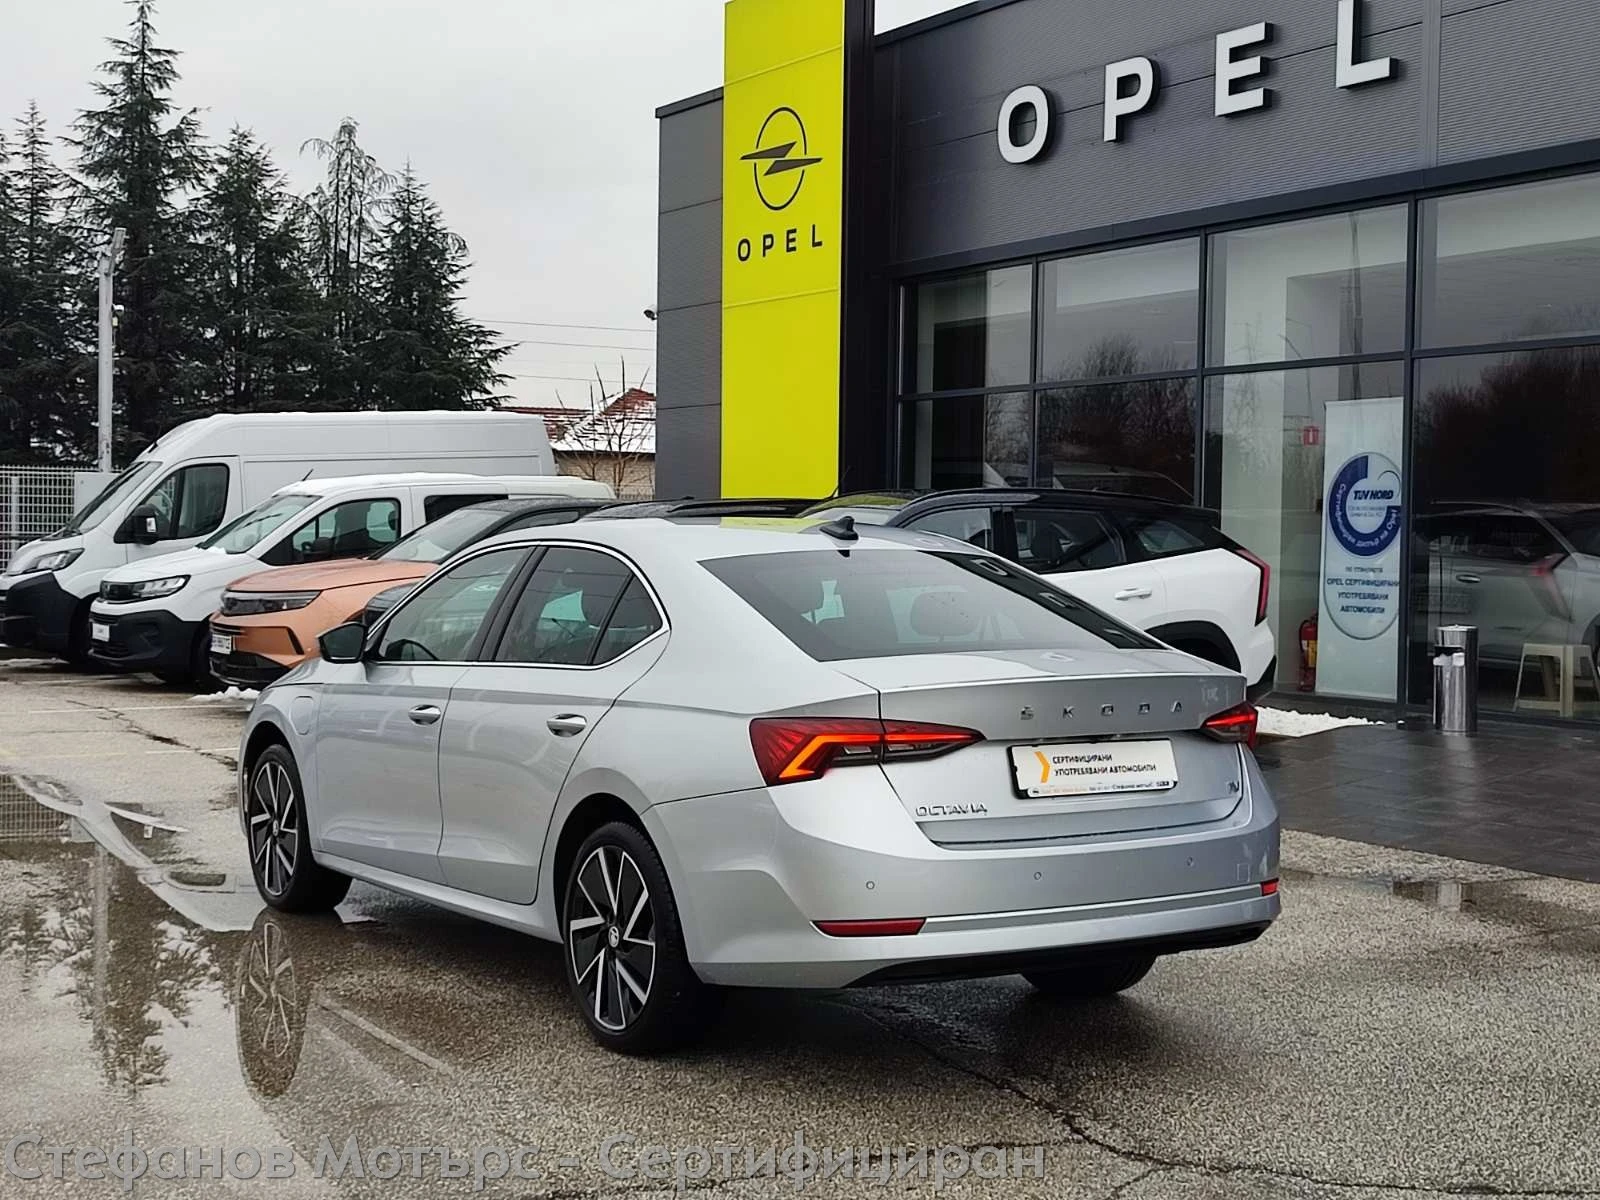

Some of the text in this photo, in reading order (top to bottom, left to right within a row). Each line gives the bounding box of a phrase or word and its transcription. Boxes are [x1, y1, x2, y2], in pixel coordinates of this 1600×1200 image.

[997, 0, 1397, 164] OPEL
[737, 224, 823, 262] OPEL
[1369, 490, 1394, 500] NORD
[1052, 753, 1113, 764] СЕРТИФИЦИРАНИ
[1054, 763, 1157, 777] УПОТРЕБЯВАНИ АВТОМОБИЛИ
[915, 802, 988, 817] OCTAVIA
